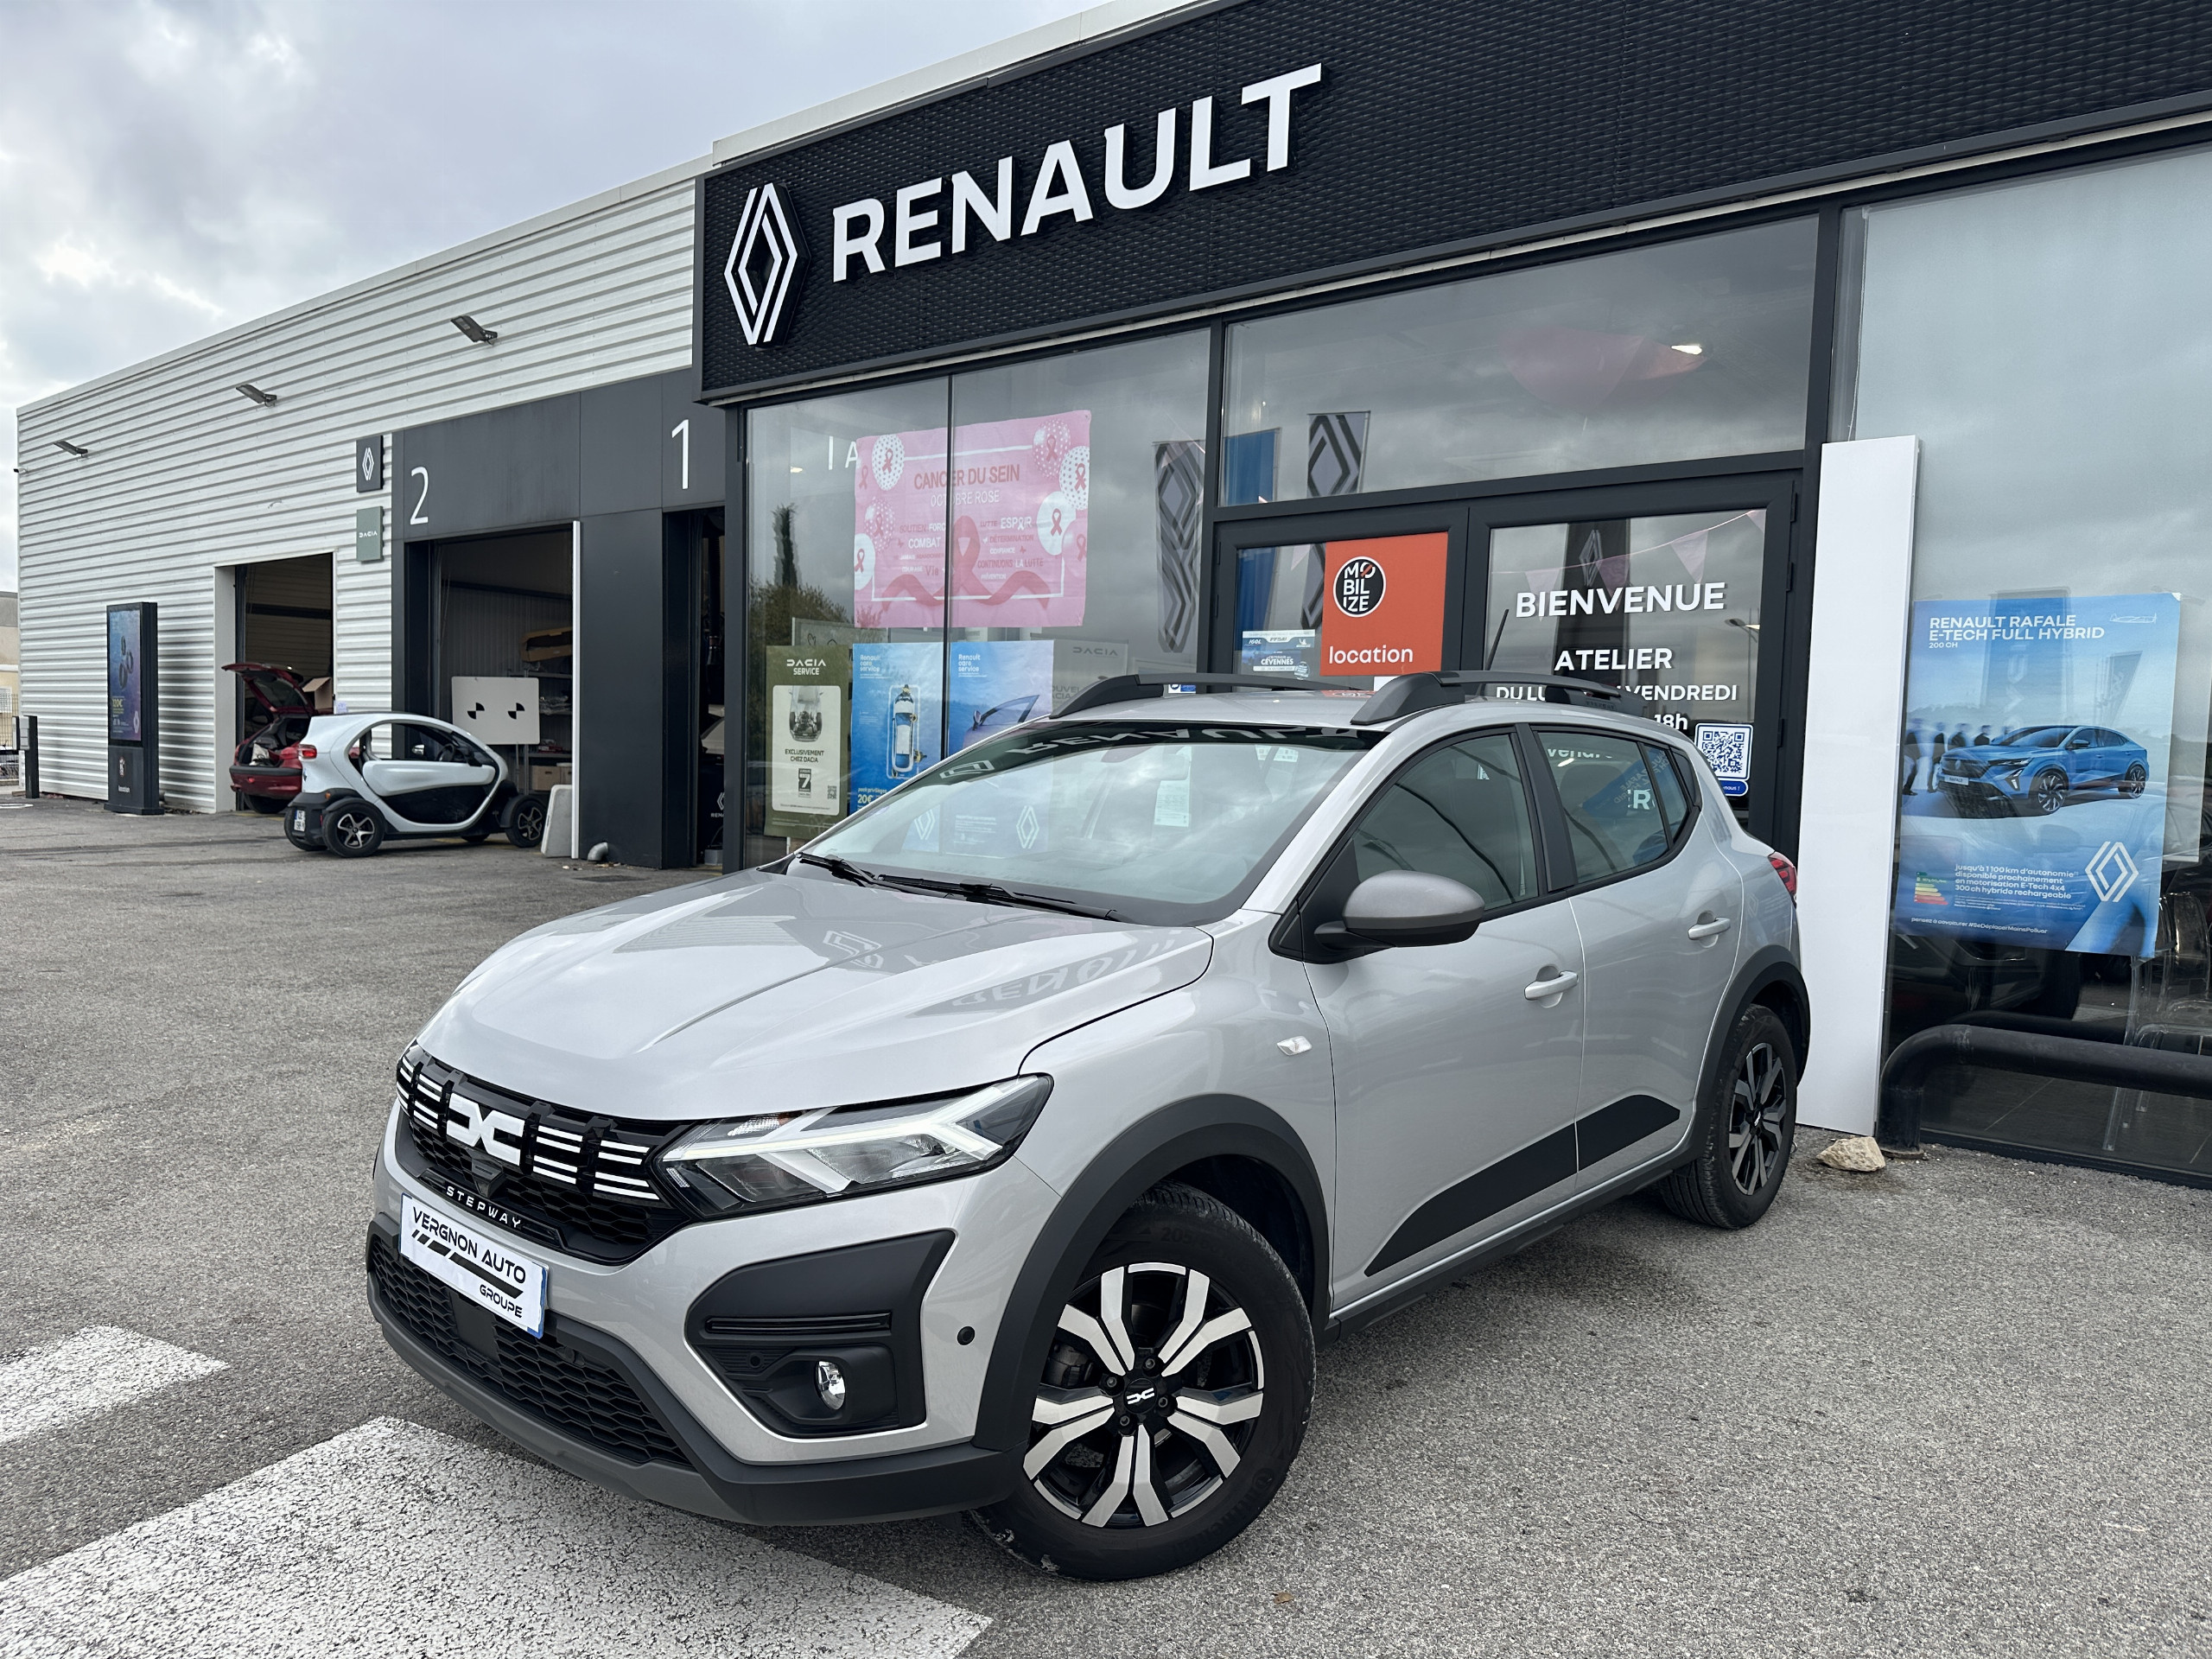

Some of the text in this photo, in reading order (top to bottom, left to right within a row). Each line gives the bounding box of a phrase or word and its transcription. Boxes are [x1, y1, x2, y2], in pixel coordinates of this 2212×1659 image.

[832, 62, 1322, 283] RENAULT
[671, 419, 689, 489] 1
[914, 464, 1020, 490] CANCER DU SEIN
[410, 467, 429, 525] 2
[975, 490, 1000, 505] ROSE
[928, 522, 946, 532] FORC
[907, 537, 941, 550] COMBAT
[1014, 559, 1024, 568] LA
[1516, 582, 1727, 618] BIENVENUE
[1929, 614, 2076, 629] RENAULT RAFALE
[1929, 626, 2105, 641] E-TECH FULL HYBRID
[1072, 646, 1118, 656] DACIA
[1329, 645, 1414, 664] location
[786, 658, 827, 667] DACIA
[1554, 647, 1673, 671] ATELIER
[793, 667, 820, 676] SERVICE
[1496, 686, 1523, 701] DU
[1955, 871, 2063, 884] disponible prochainement
[1966, 879, 2019, 888] motorisation
[1981, 886, 2013, 895] hybride
[2013, 888, 2072, 899] rechargeable
[446, 1185, 521, 1229] STEPWAY
[412, 1206, 526, 1284] VERGNON AUTO
[479, 1284, 523, 1319] GROUPE
